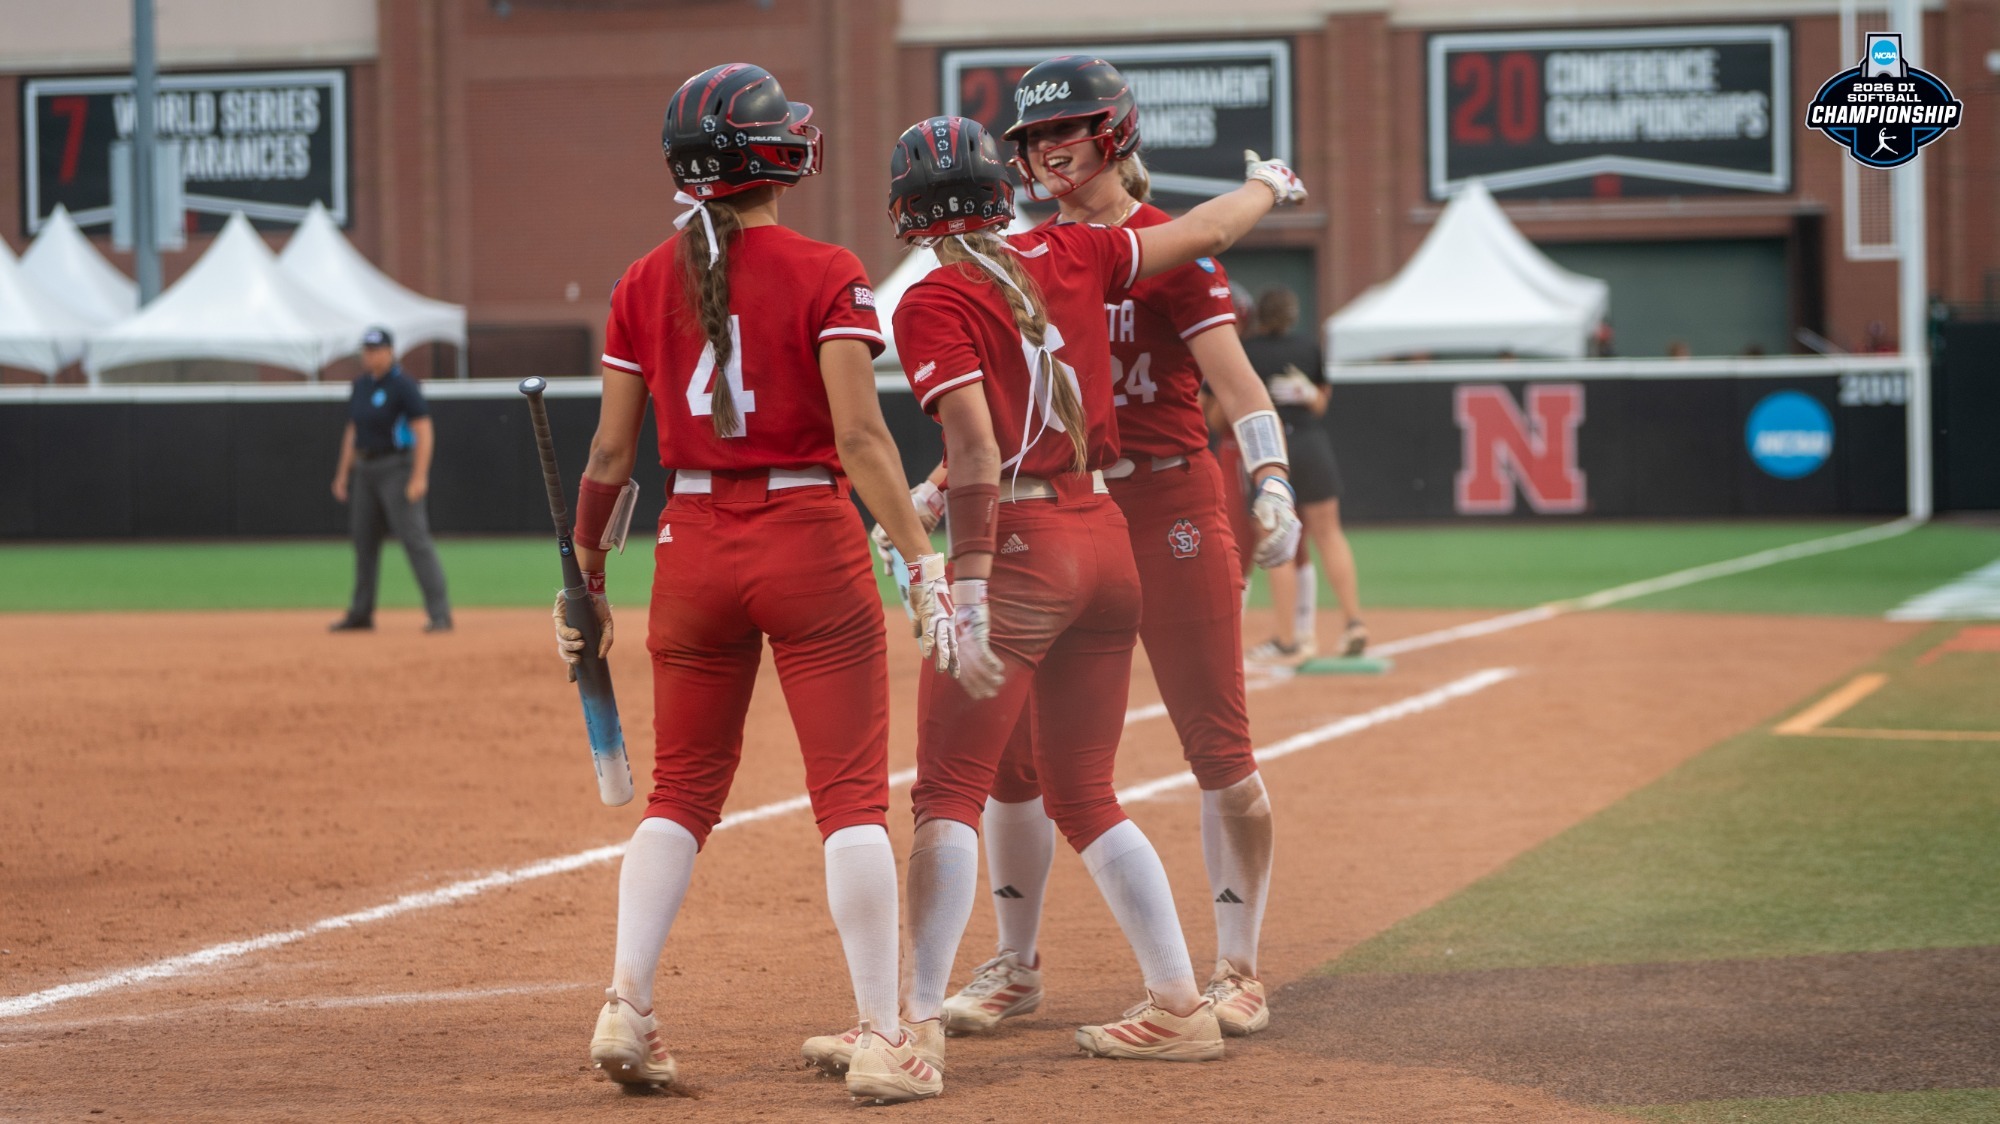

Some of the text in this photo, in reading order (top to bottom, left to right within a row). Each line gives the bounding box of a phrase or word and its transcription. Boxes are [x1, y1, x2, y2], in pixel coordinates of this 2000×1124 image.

[1545, 49, 1719, 96] CONFERENCE
[219, 88, 321, 134] SERIES
[1014, 80, 1072, 120] Yotes
[1452, 52, 1539, 144] 20
[1545, 92, 1768, 143] CHAMPIONSHIPS
[52, 95, 88, 185] 7
[183, 134, 311, 181] ARANCES
[690, 159, 701, 175] 4
[948, 196, 959, 212] 6
[685, 315, 756, 438] 4
[1455, 383, 1586, 514] N
[1000, 543, 1030, 554] adidas
